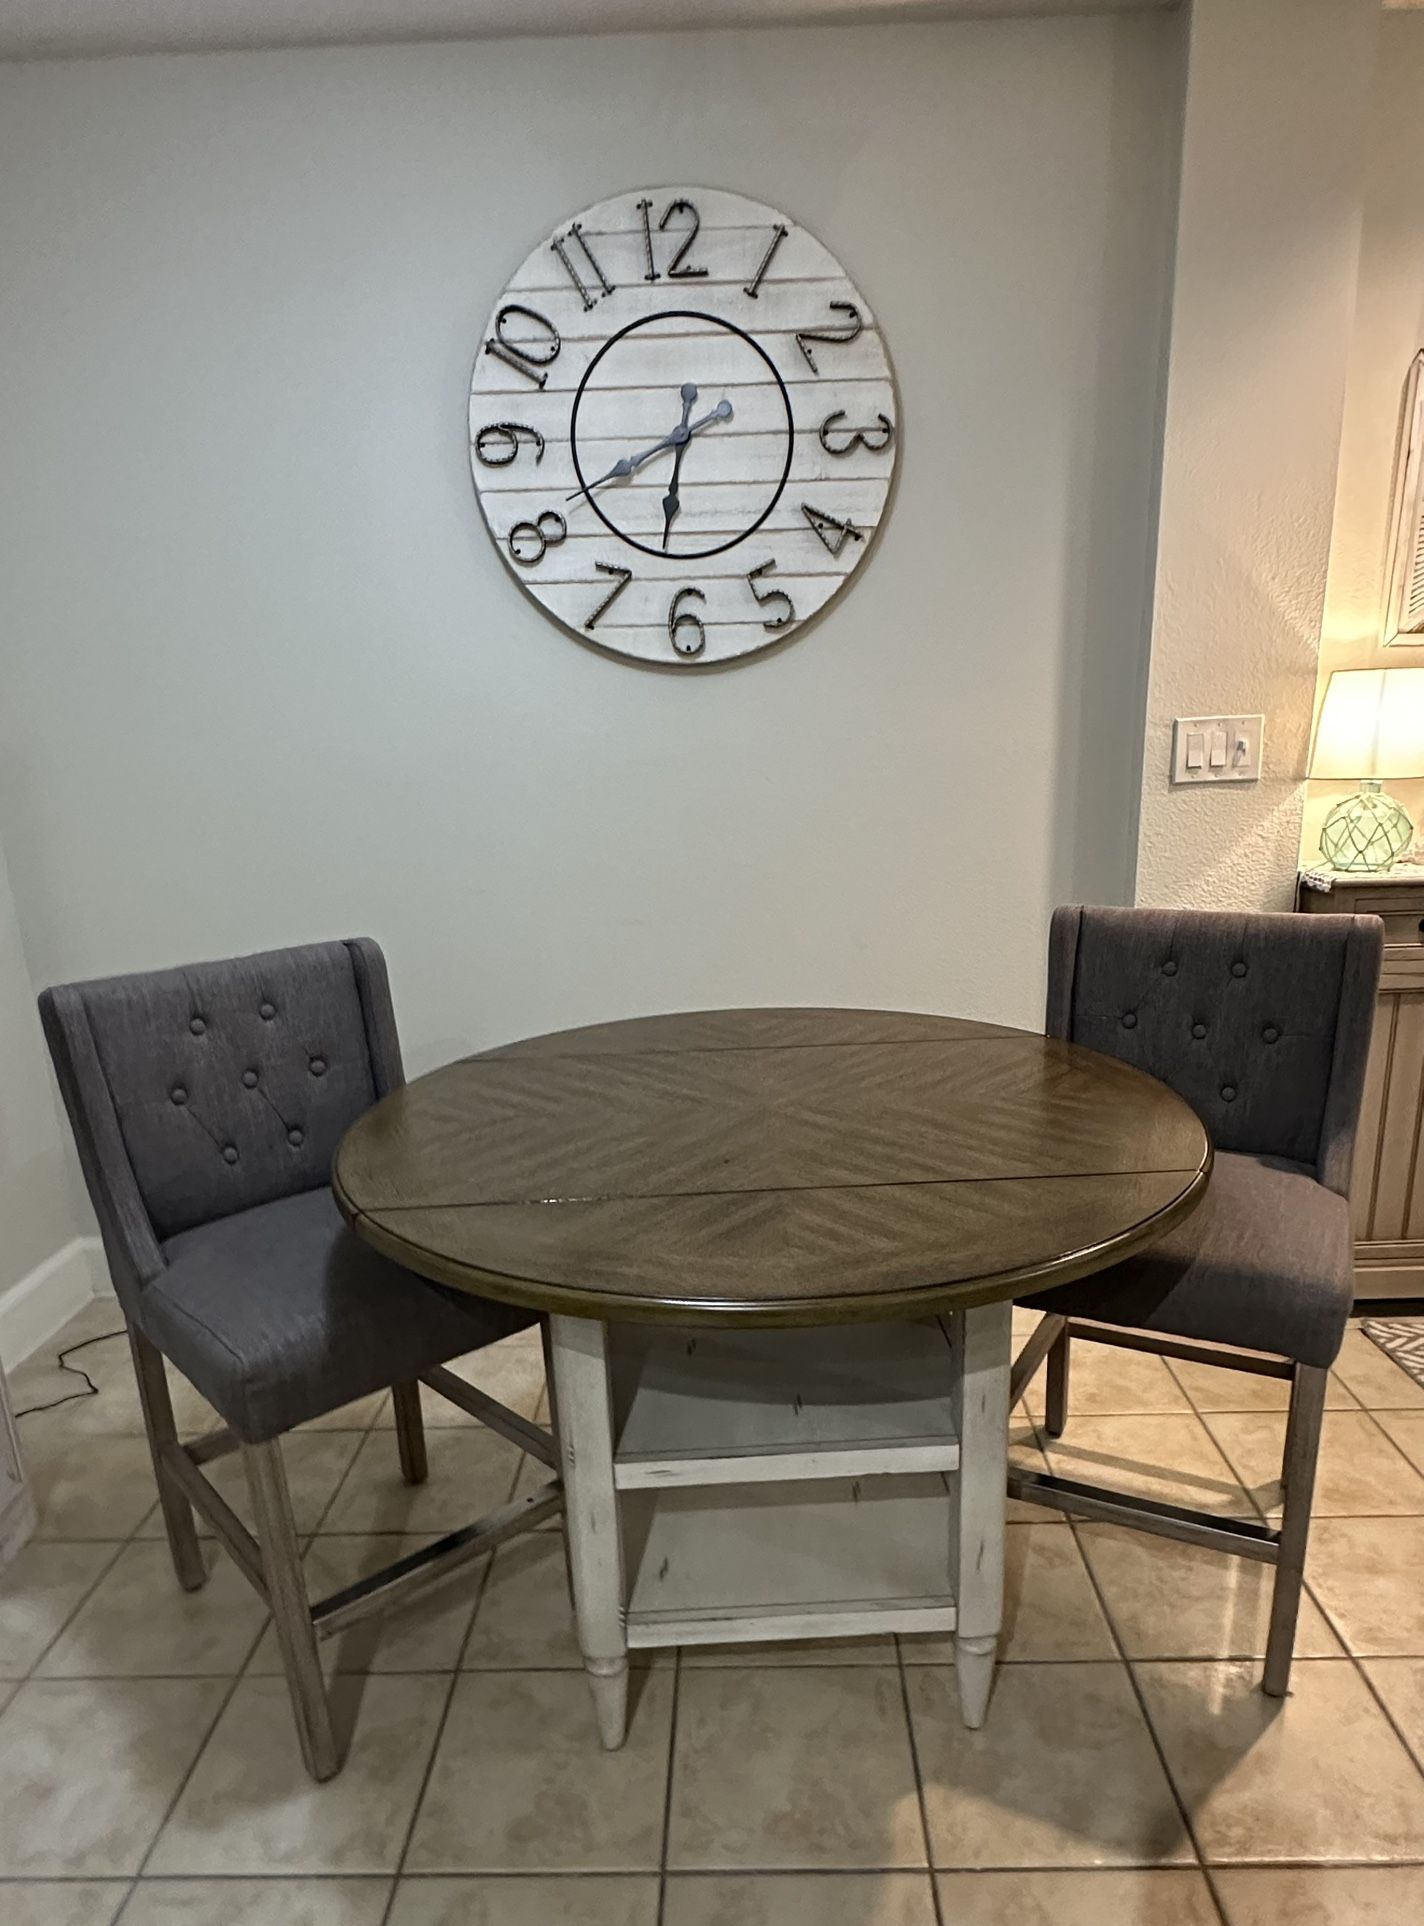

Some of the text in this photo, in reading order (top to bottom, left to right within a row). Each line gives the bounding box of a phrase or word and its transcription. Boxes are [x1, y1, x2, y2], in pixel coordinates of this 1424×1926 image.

[551, 223, 616, 313] 11
[636, 198, 709, 282] 12
[743, 224, 788, 299] 1
[485, 304, 561, 390] 10
[796, 300, 863, 375] 2
[476, 421, 545, 467] 9
[819, 409, 894, 456] 3
[508, 510, 567, 564] 8
[801, 502, 865, 557] 4
[584, 561, 632, 632] 7
[667, 586, 706, 657] 6
[746, 558, 795, 631] 5
